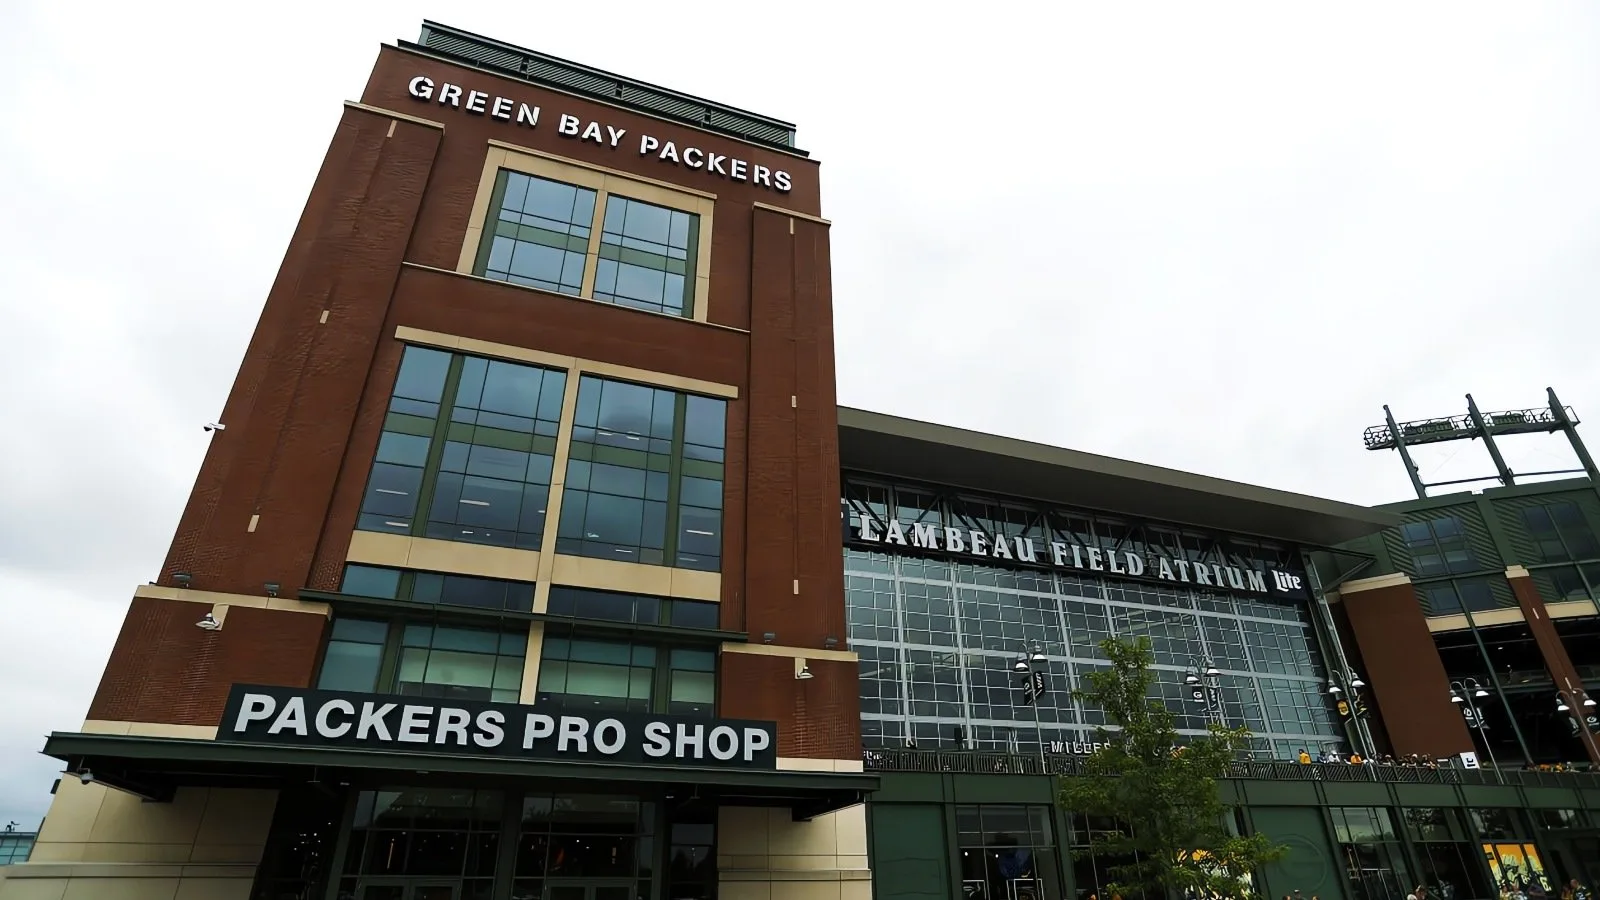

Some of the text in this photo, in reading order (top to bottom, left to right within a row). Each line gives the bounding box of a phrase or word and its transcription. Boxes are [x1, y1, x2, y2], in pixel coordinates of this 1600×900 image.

[408, 76, 793, 193] GREEN BAY PACKERS
[860, 513, 1268, 593] LAMBEAU FIELD ATRIUM
[1271, 569, 1302, 592] Lite
[233, 693, 770, 762] PACKERS PRO SHOP
